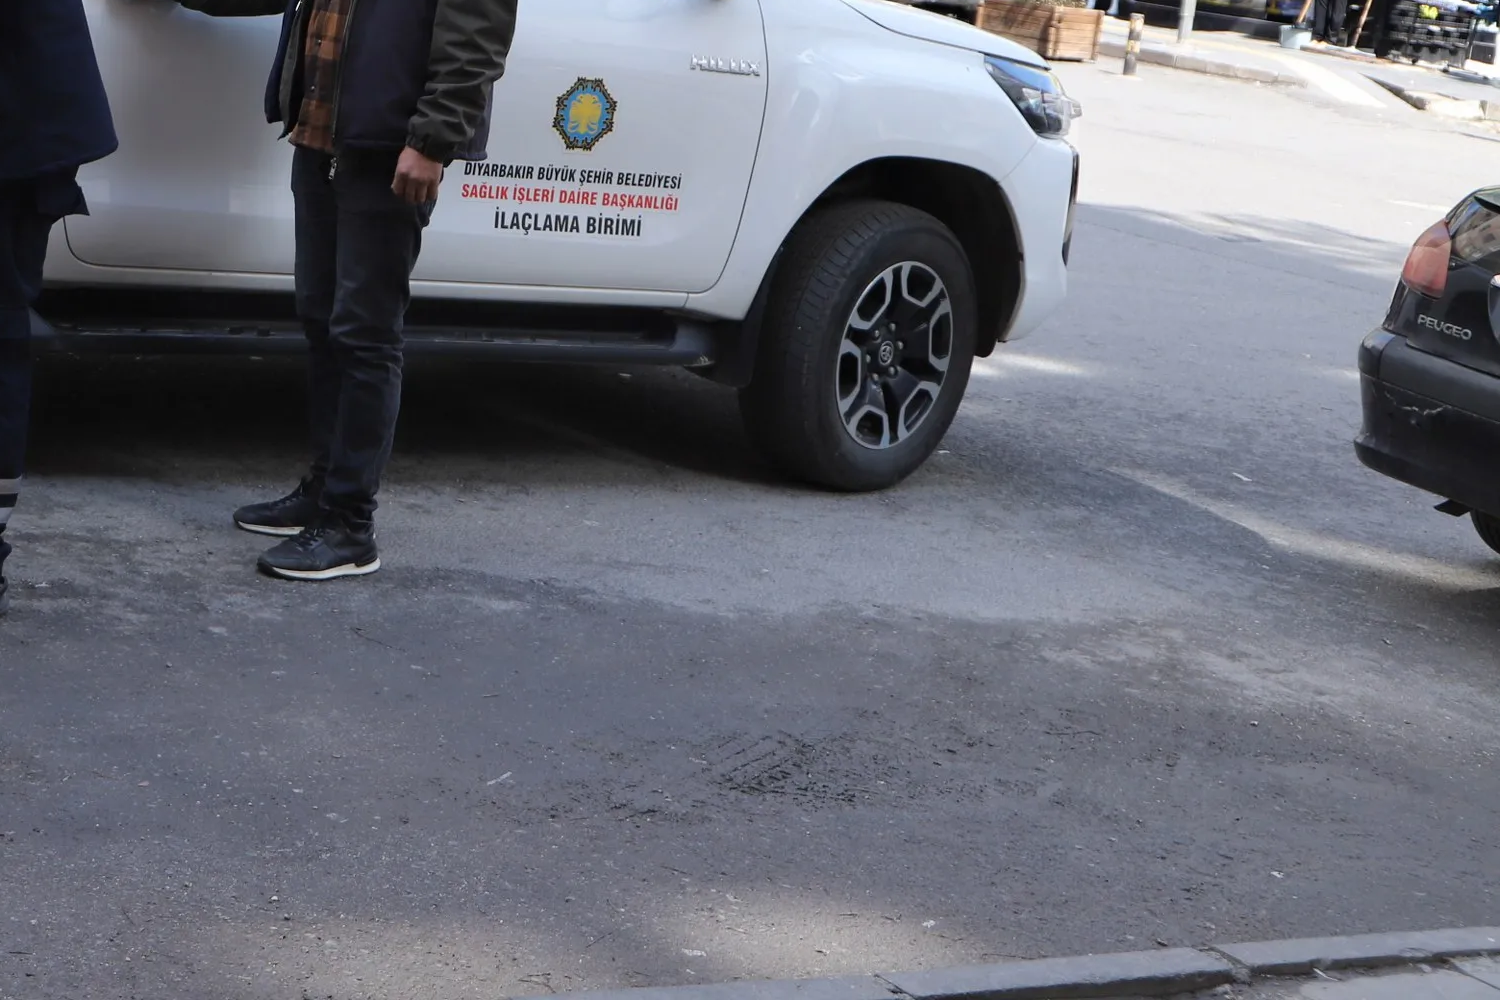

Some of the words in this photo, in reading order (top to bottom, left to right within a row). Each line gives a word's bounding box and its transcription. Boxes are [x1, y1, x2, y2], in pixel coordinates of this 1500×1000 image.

[690, 53, 760, 77] HILUX
[537, 164, 576, 184] BÜYÜK
[579, 167, 614, 187] ŞEHİR
[617, 171, 683, 190] BELEDİYESİ
[461, 181, 509, 200] SAĞLIK
[512, 183, 555, 206] İŞLERİ
[559, 187, 598, 206] DAİRE
[602, 191, 679, 212] BAŞKANLIĞI
[494, 206, 581, 236] İLAÇLAMA
[586, 212, 642, 237] BİRİMİ
[1417, 313, 1473, 340] PEUGEO
